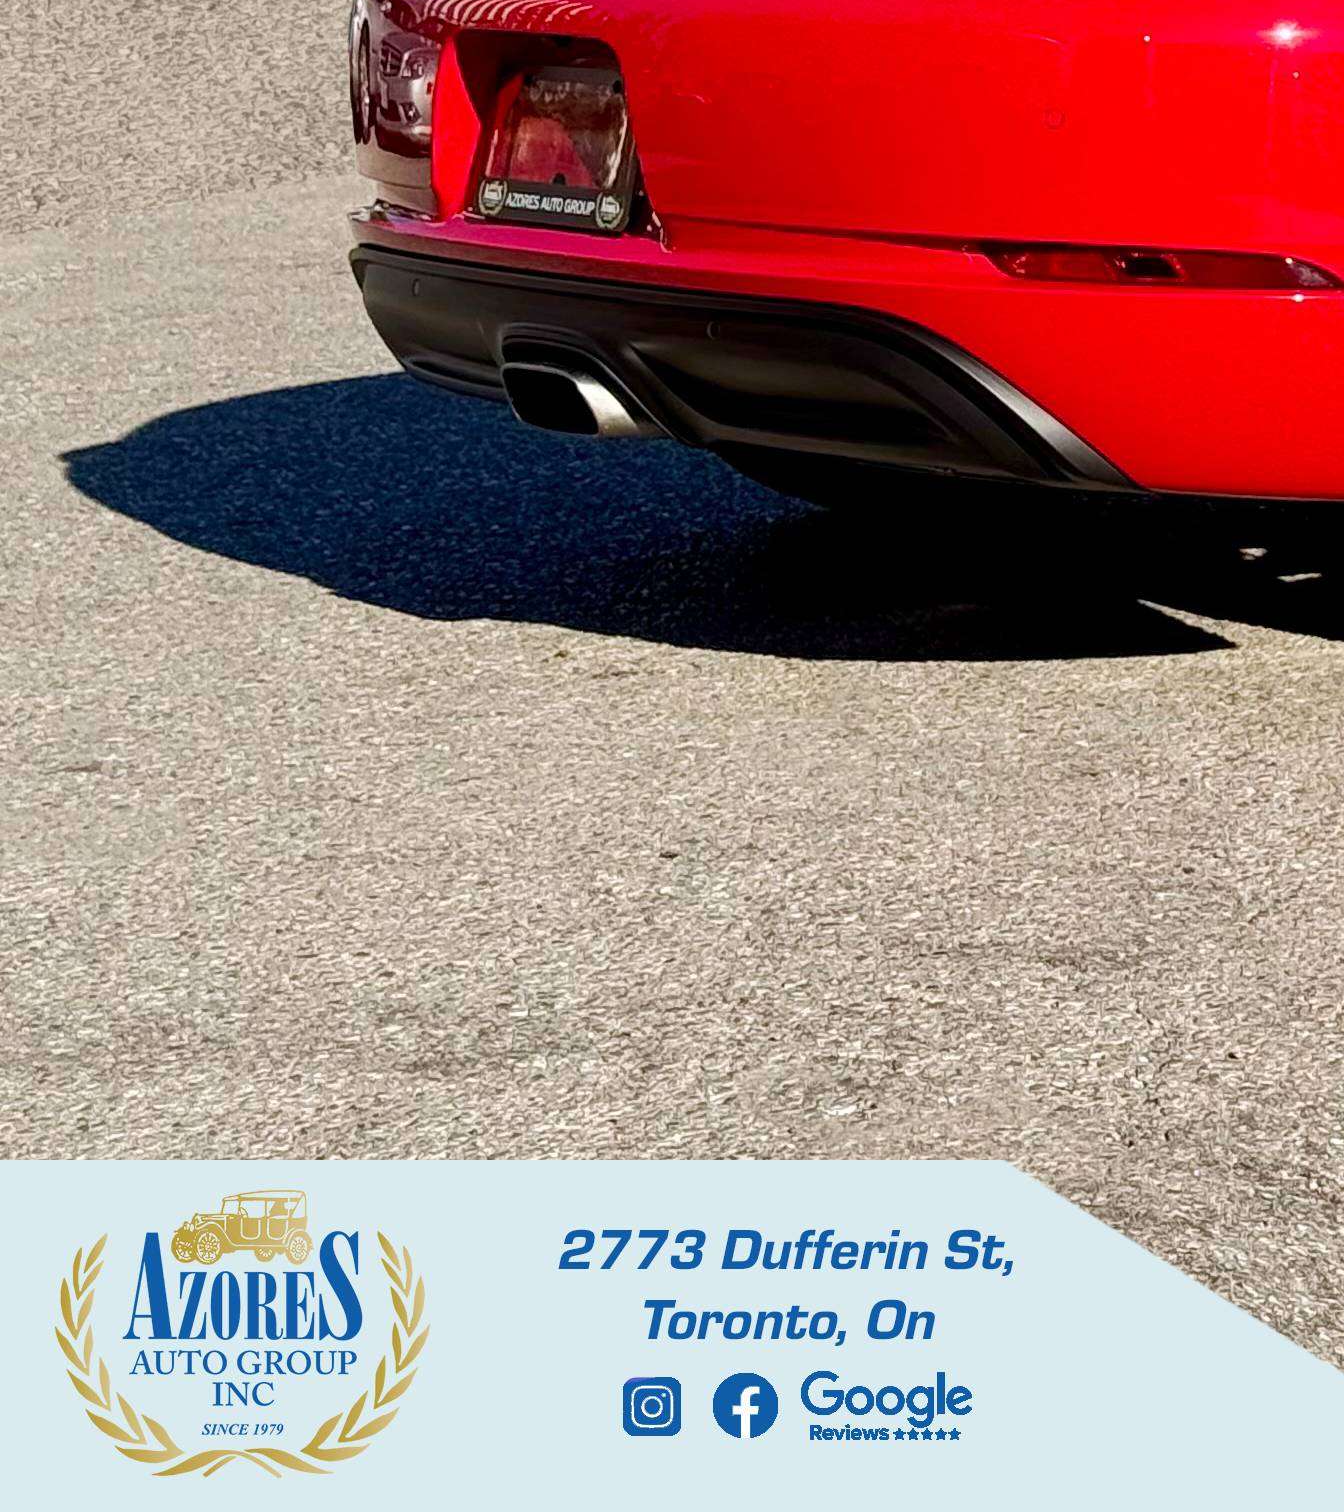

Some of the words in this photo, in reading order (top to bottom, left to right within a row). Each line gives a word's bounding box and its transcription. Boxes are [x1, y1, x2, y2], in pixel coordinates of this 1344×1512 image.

[505, 192, 540, 210] AZORES
[540, 196, 563, 212] AUTO
[564, 199, 596, 216] GROUP
